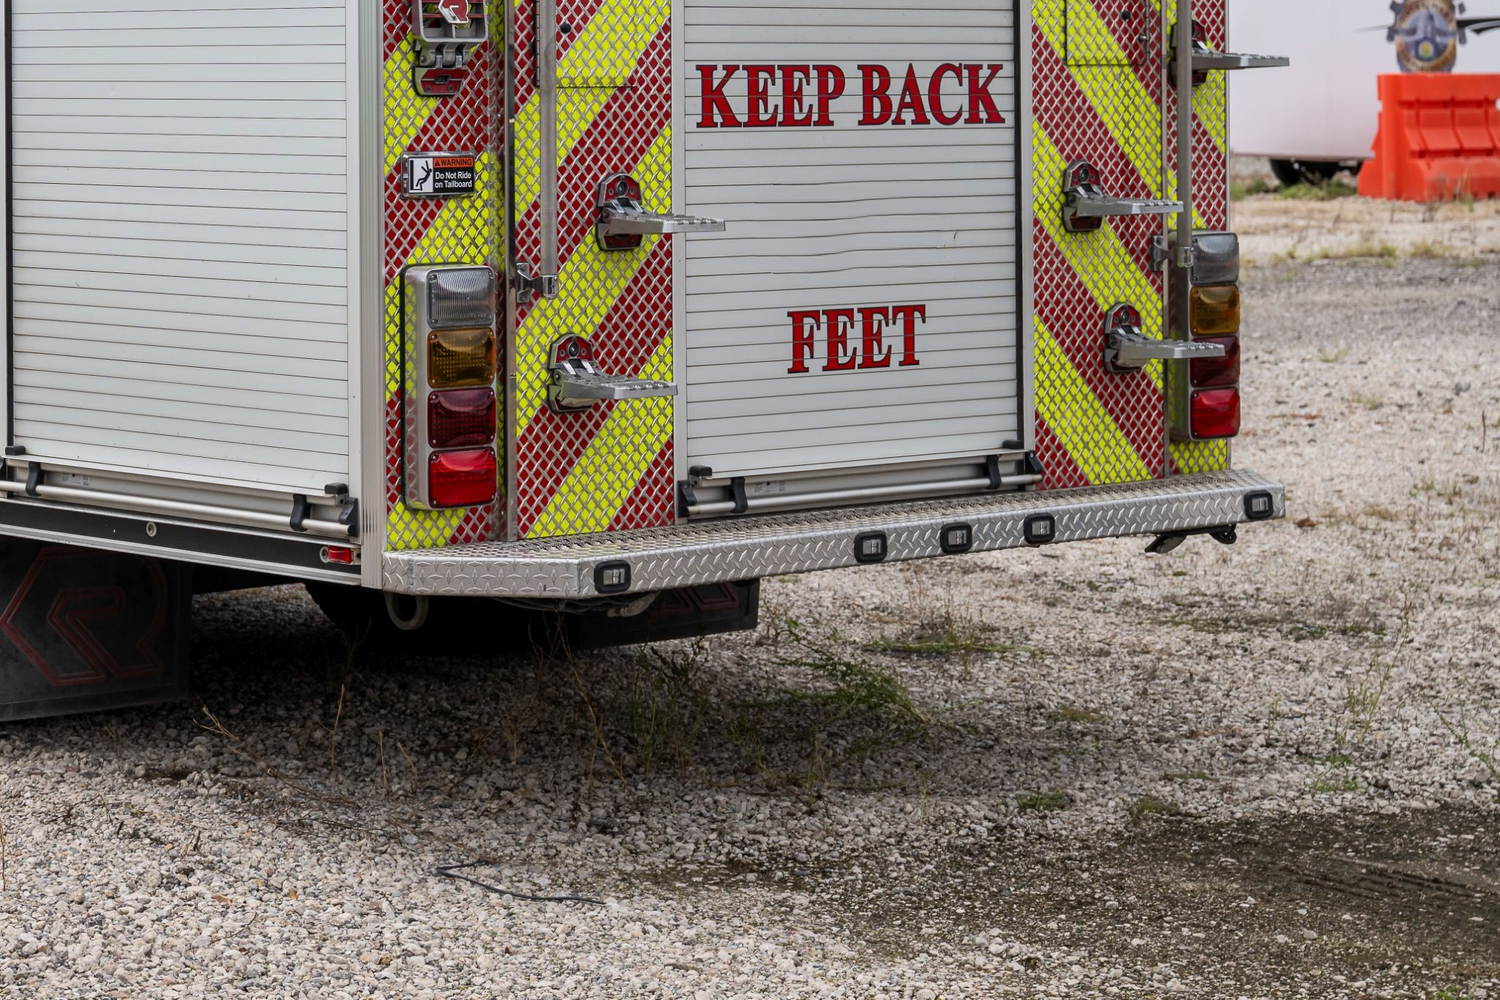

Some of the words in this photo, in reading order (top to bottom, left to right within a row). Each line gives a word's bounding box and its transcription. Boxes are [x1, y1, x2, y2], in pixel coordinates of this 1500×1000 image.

[695, 64, 846, 128] KEEP
[856, 62, 1006, 126] BACK
[440, 158, 473, 166] WARNING
[435, 171, 445, 180] Do
[445, 171, 457, 180] Not
[457, 170, 472, 179] Ride
[444, 179, 473, 189] Tailboard
[787, 304, 926, 374] FEET
